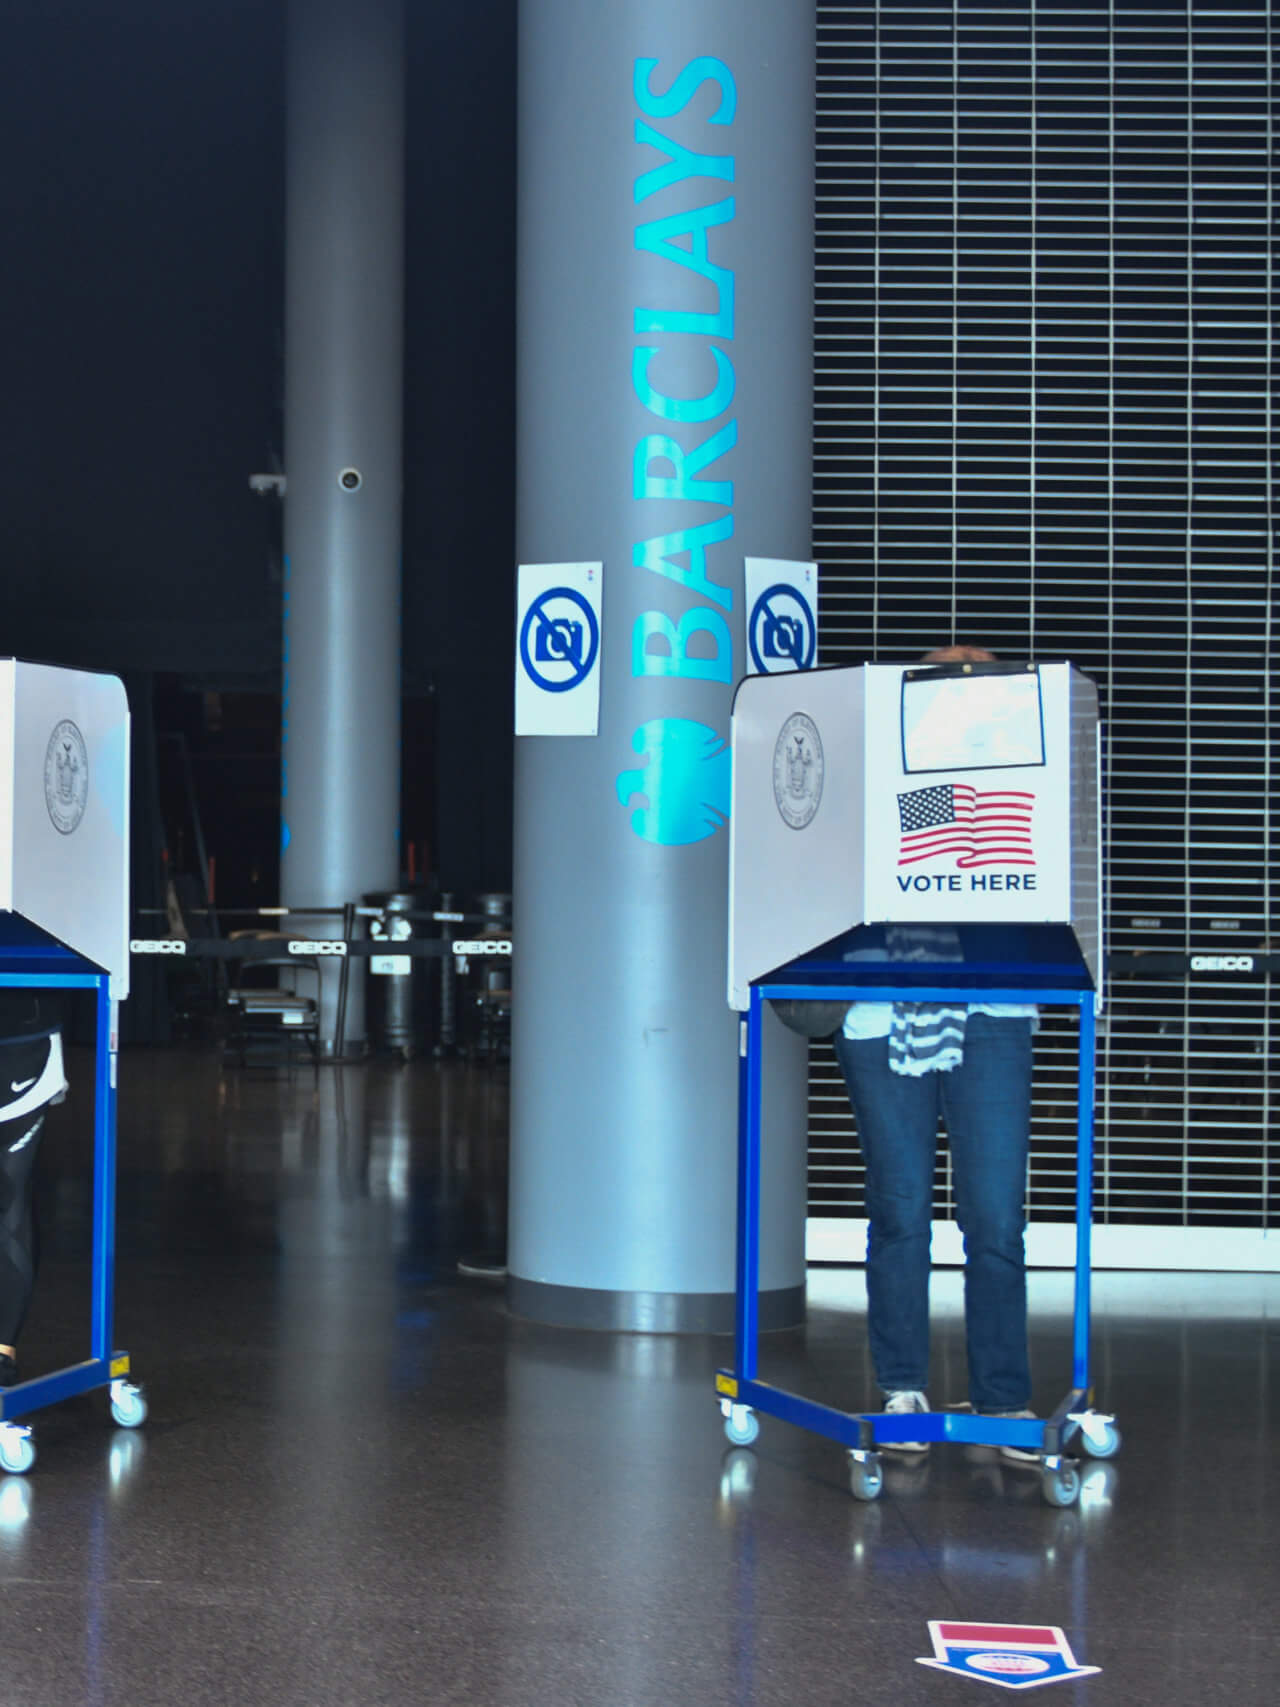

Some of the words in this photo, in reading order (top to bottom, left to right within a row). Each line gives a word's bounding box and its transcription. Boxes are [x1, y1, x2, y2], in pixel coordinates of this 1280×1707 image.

[632, 56, 737, 685] BARCLAYS
[896, 874, 962, 892] VOTE
[970, 873, 1037, 891] HERE
[288, 941, 347, 955] GEICO
[452, 940, 513, 956] GEICO
